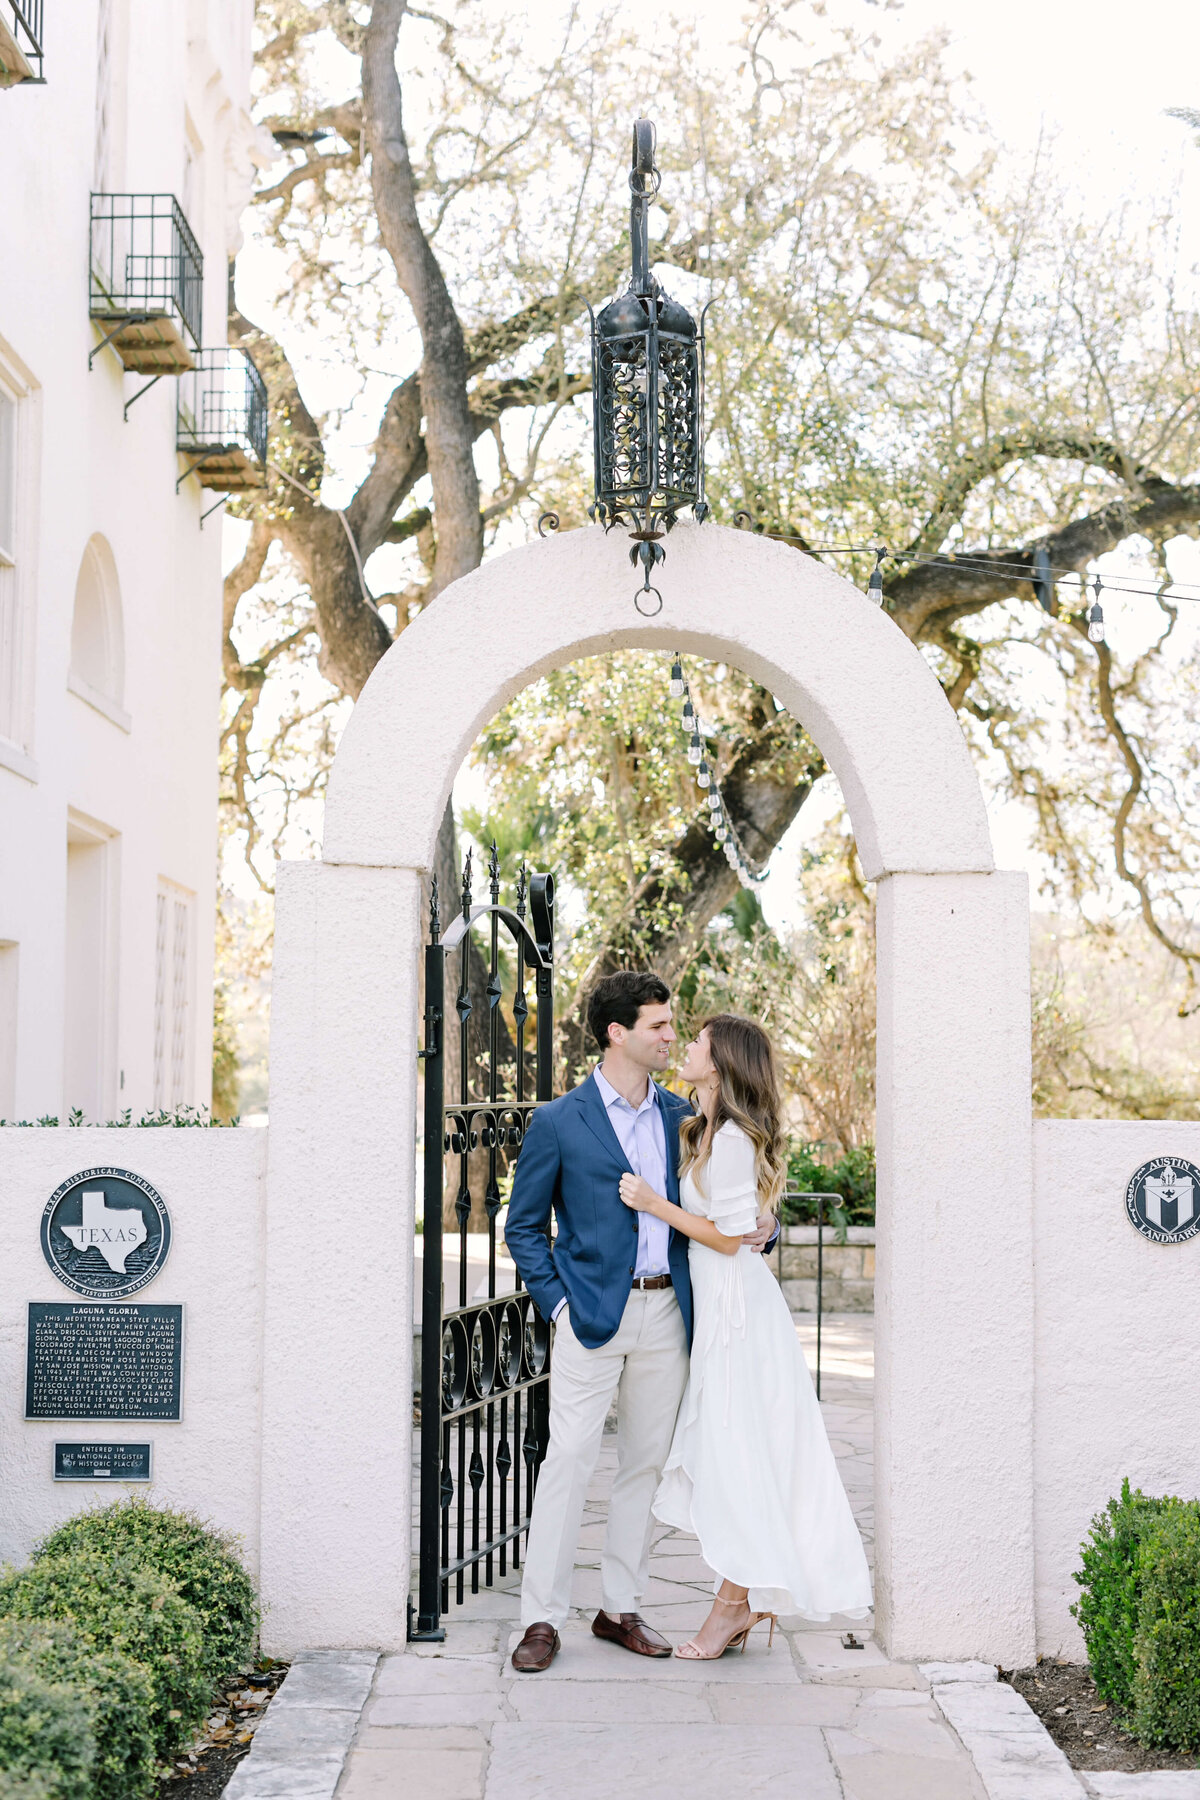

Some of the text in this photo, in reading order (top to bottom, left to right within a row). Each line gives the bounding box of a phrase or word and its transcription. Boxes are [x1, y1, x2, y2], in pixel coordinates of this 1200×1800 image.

[1150, 1158, 1190, 1171] AUSTIN
[44, 1168, 167, 1216] TEXAS HISTORICAL COMMISSION
[77, 1228, 137, 1242] TEXAS
[1139, 1225, 1200, 1242] LANDMARK
[52, 1265, 160, 1297] OFFICIAL HISTORICAL MEDALLION
